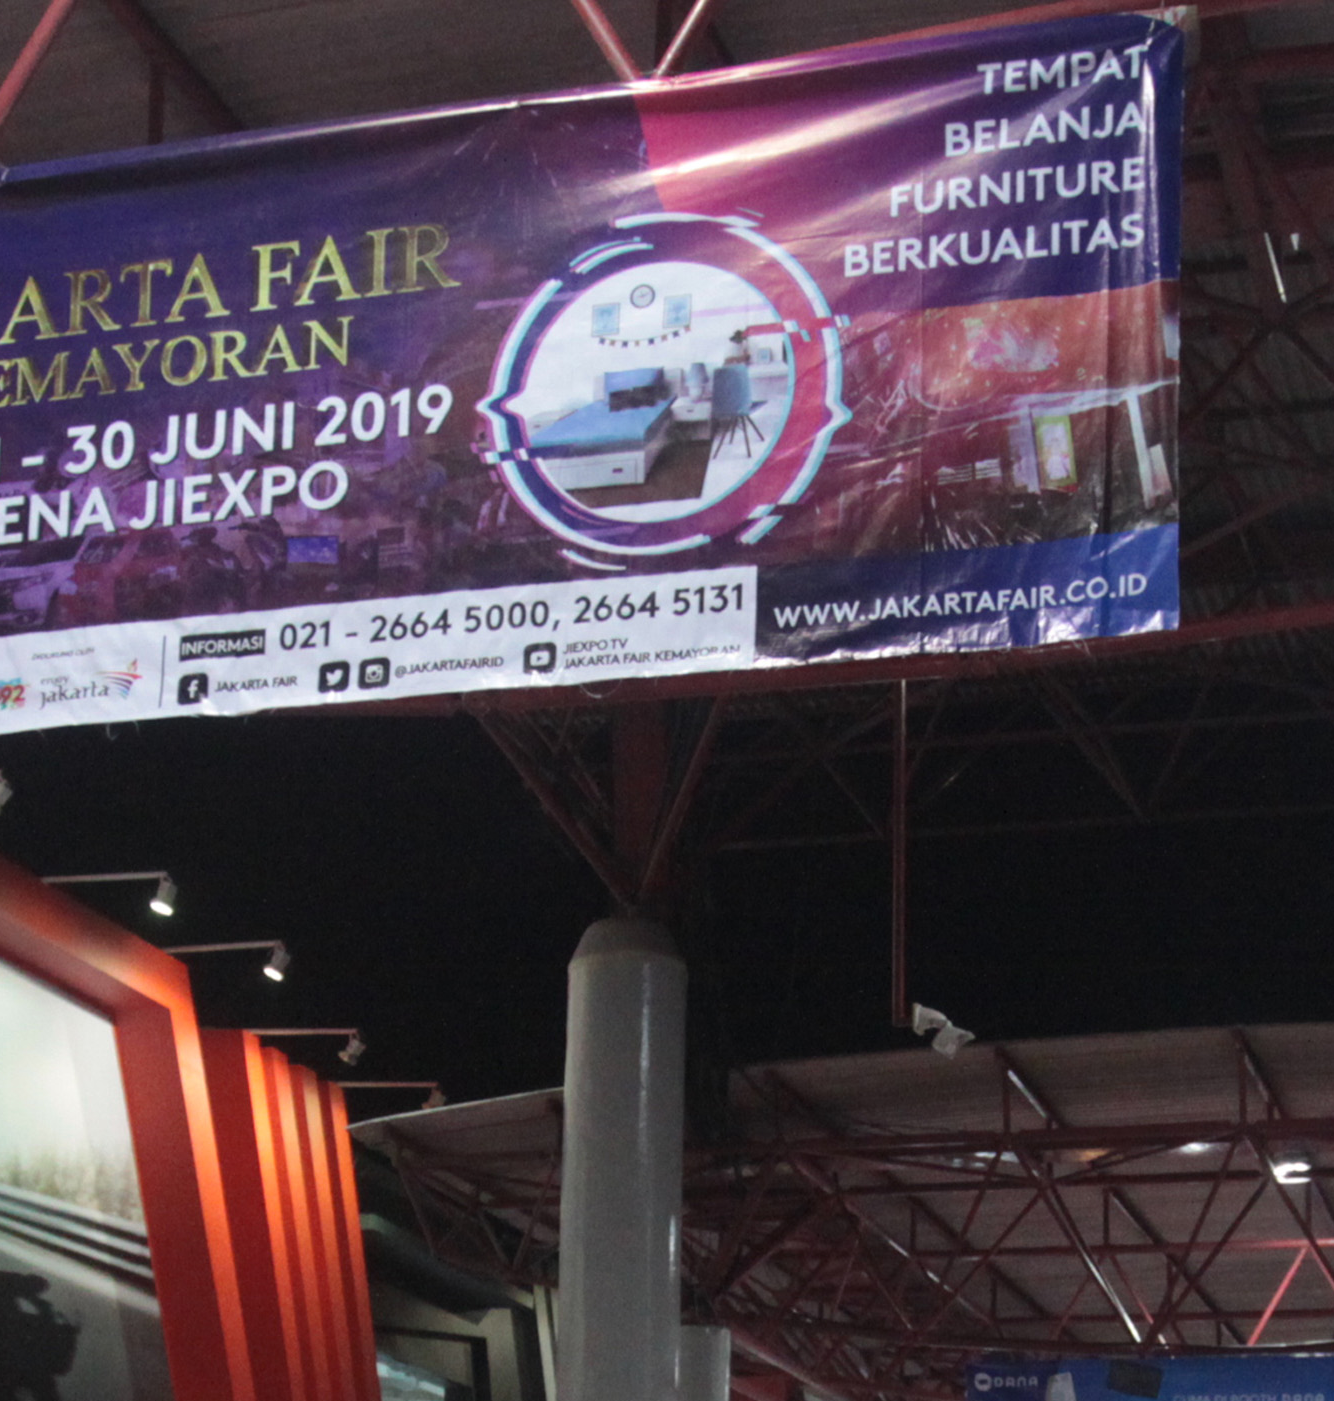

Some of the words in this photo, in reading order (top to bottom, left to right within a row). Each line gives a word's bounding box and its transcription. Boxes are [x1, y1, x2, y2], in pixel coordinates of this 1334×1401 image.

[977, 44, 1149, 94] TEMPAT
[944, 101, 1147, 157] BELANJA
[889, 156, 1146, 218] FURNITURE
[250, 223, 462, 311] FAIR
[844, 213, 1145, 278] BERKUALITAS
[64, 420, 135, 475] 30
[149, 400, 295, 466] JUNI
[312, 384, 454, 446] 2019
[128, 460, 349, 530] JIEXPO
[180, 636, 264, 656] INFORMASI
[279, 620, 332, 651] 021
[369, 608, 451, 643] 2664
[464, 600, 560, 633] 5000,
[573, 591, 660, 624] 2664
[672, 583, 743, 616] 5131
[773, 572, 1148, 629] WWW.JAKARTAFAIR.CO.ID
[394, 656, 505, 678] @JAKARTAFAIRID
[563, 638, 608, 654] JIEXPO
[610, 638, 628, 650] TV
[564, 653, 621, 669] JAKARTA
[623, 652, 651, 664] FAIR
[214, 679, 269, 693] JAKARTA
[271, 675, 298, 688] FAIR
[994, 1375, 1038, 1388] DANA
